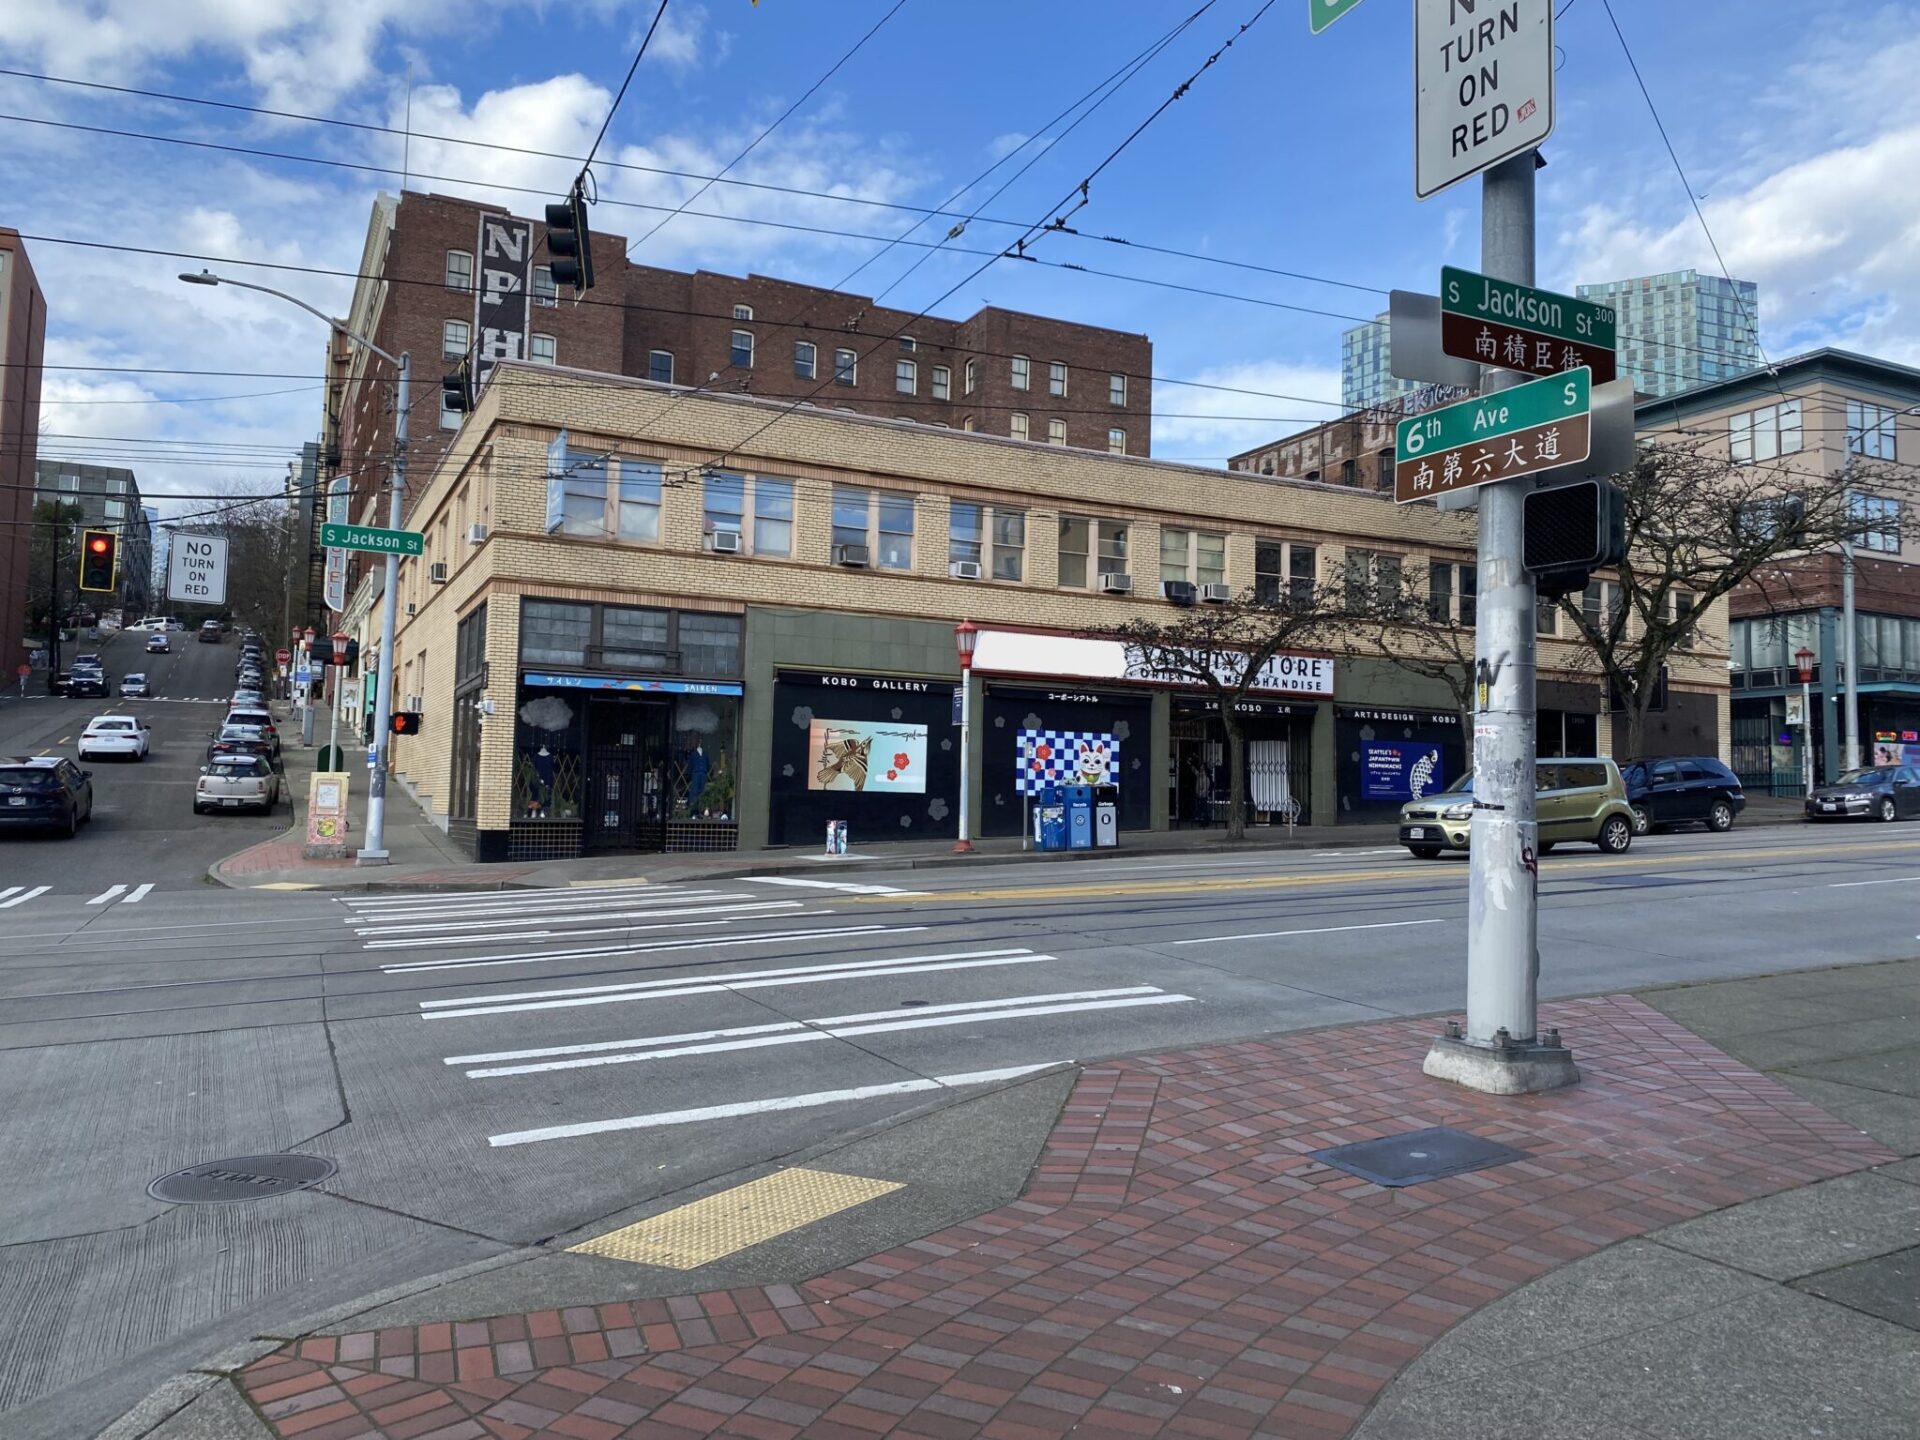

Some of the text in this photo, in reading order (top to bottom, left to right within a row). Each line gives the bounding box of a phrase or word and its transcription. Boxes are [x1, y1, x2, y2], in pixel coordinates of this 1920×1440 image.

[1440, 2, 1518, 73] TURN
[1459, 60, 1498, 107] ON
[1452, 103, 1509, 158] RED
[1449, 280, 1614, 336] S Jackson St 300
[1475, 326, 1583, 372] 南積臣街
[1406, 382, 1577, 453] 6th Ave S
[1413, 427, 1562, 491] 南第六大道
[187, 541, 212, 556] NO
[327, 530, 418, 551] S Jackson St
[182, 557, 215, 570] TURN
[189, 571, 206, 582] ON
[185, 584, 209, 596] RED
[1268, 656, 1322, 678] TORE
[822, 676, 928, 692] KOBO GALLERY
[1224, 675, 1322, 691] MECHANDISE
[1235, 703, 1262, 713] KOBO
[1354, 711, 1371, 719] ART
[1432, 716, 1456, 724] KOBO
